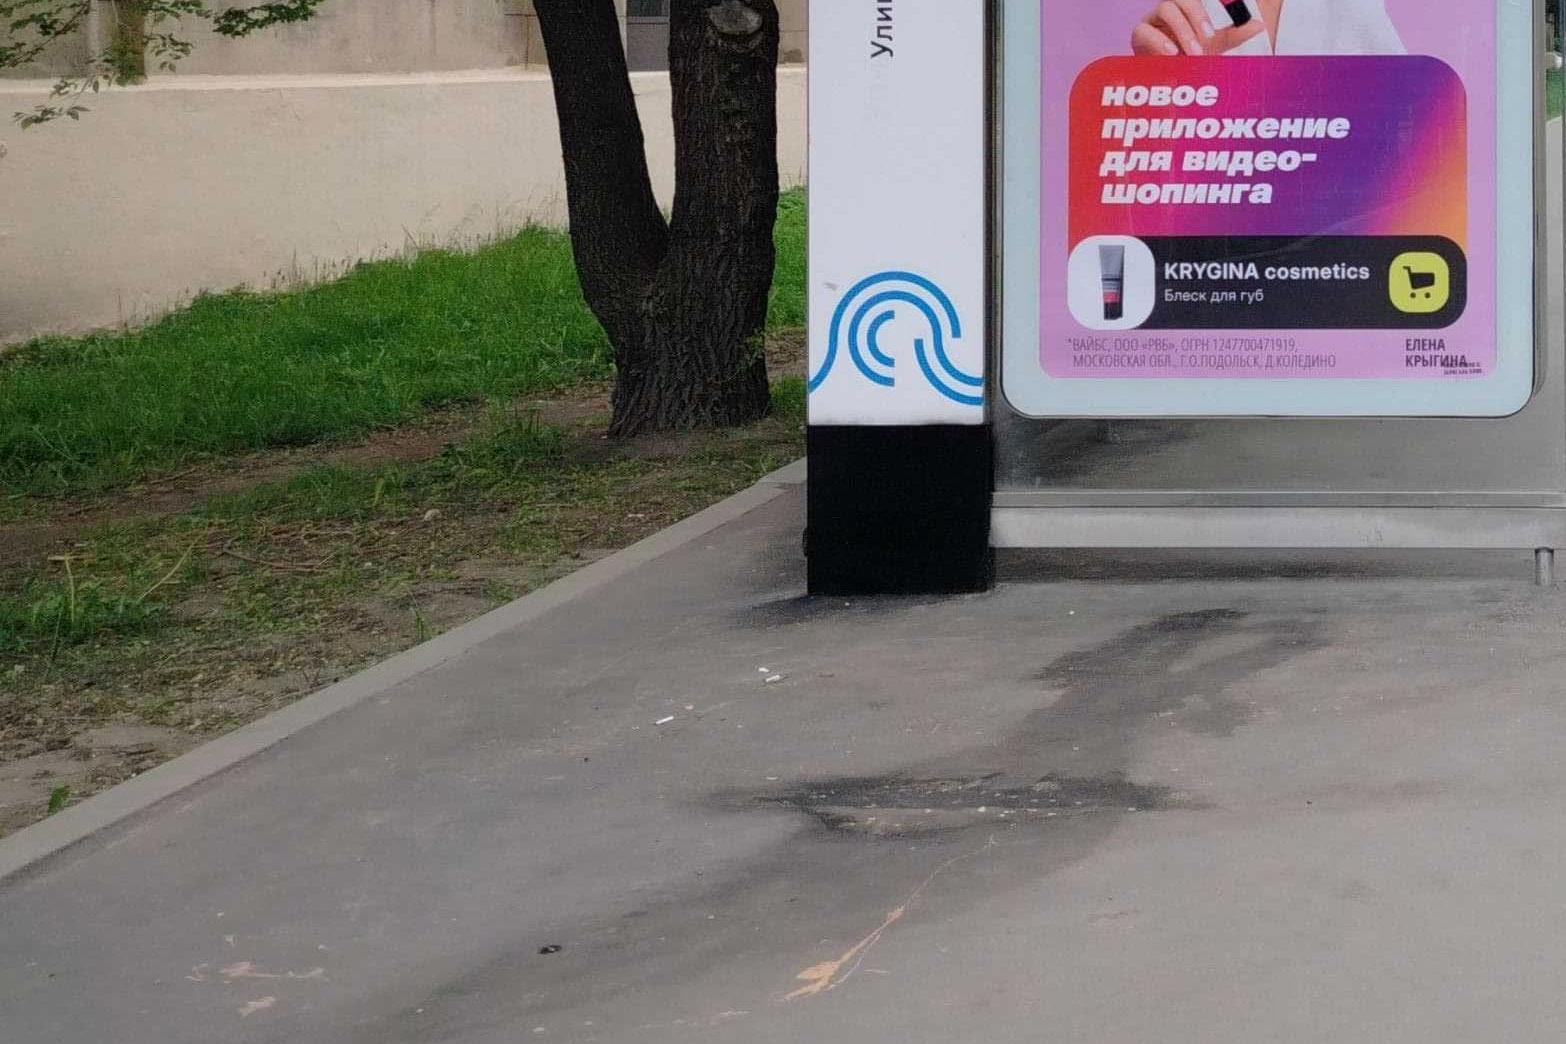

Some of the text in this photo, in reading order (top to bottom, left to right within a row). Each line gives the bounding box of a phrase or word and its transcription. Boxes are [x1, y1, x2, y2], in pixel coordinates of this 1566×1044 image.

[1101, 85, 1219, 106] новое
[1101, 117, 1351, 147] приложение
[1099, 150, 1317, 176] для видео-
[1101, 183, 1273, 204] шопинга
[1164, 262, 1370, 280] KRYGINA cosmetics
[1164, 289, 1264, 304] Блеск для губ
[1114, 338, 1138, 351] ООО
[1181, 338, 1208, 351] ОГРН
[1405, 339, 1445, 351] ЕЛЕНА
[1073, 355, 1146, 367] МОСКОВСКАЯ
[1405, 355, 1467, 367] КРЫГИНА
